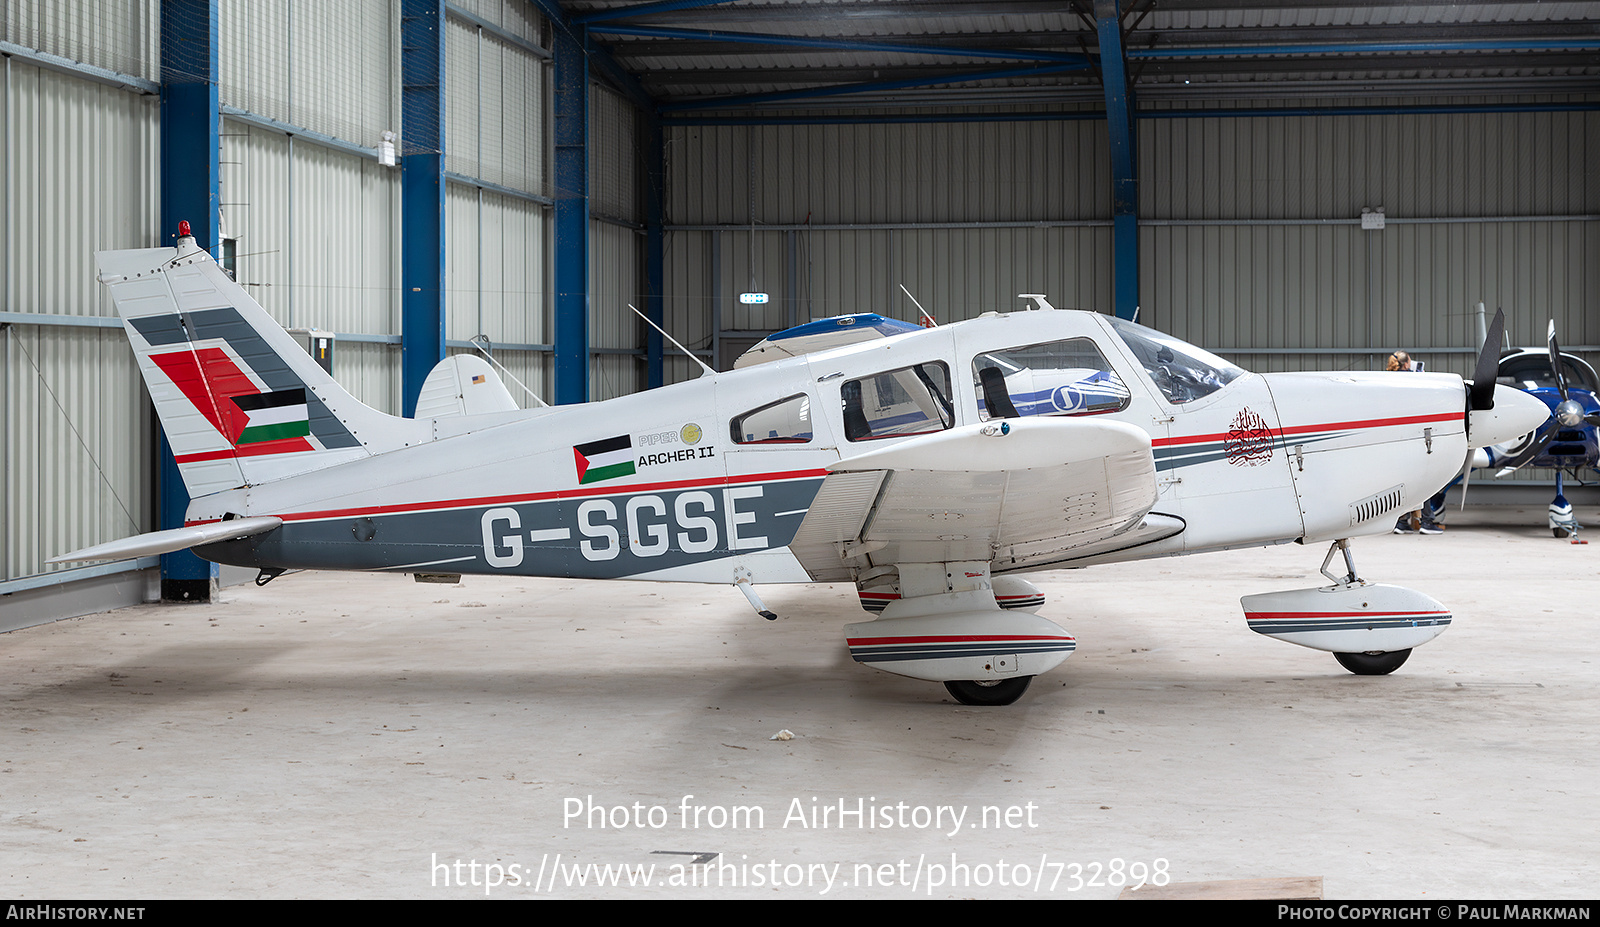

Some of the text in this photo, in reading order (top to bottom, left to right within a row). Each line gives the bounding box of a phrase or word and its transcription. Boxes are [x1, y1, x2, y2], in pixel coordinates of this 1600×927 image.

[638, 430, 679, 447] PIPER
[638, 445, 715, 468] ARCHER II
[481, 485, 769, 568] G-SGSE
